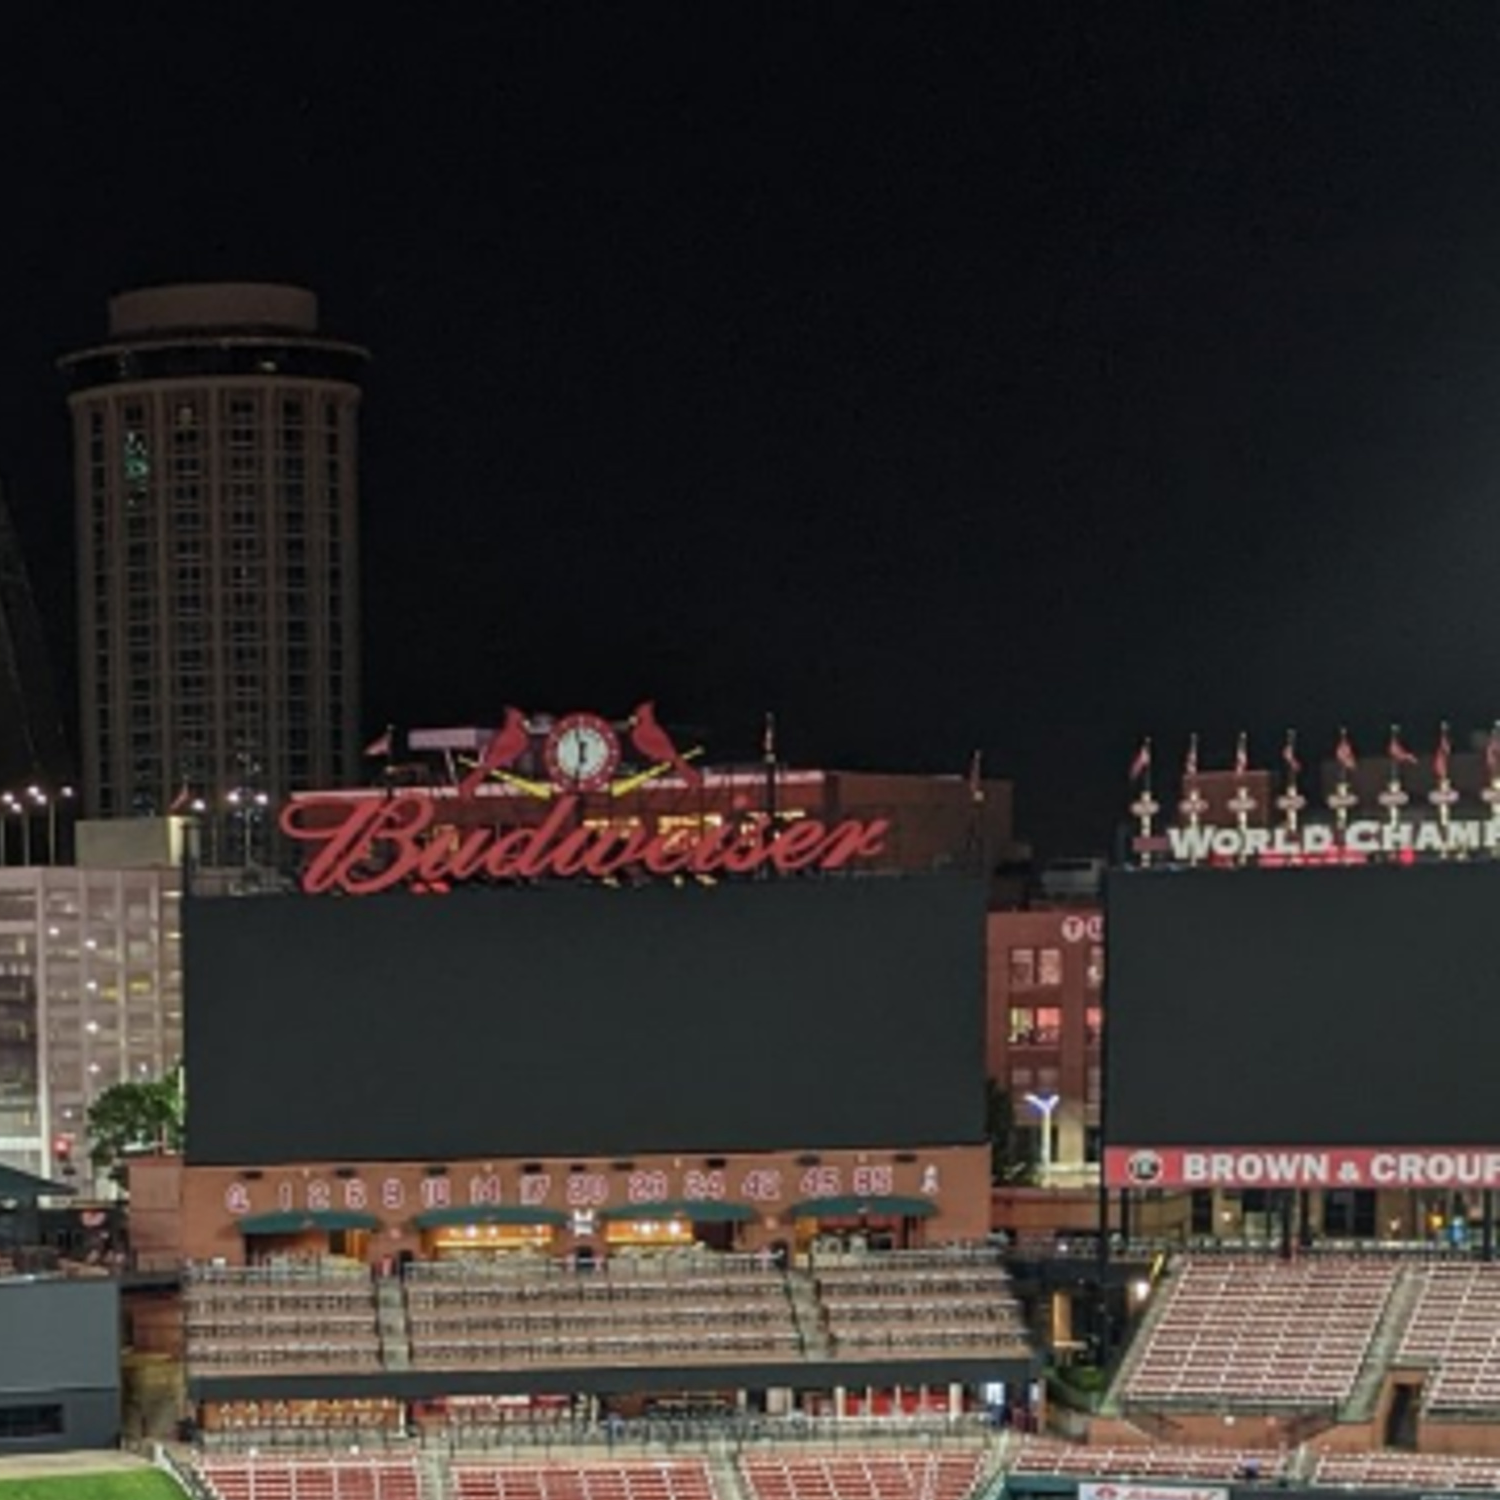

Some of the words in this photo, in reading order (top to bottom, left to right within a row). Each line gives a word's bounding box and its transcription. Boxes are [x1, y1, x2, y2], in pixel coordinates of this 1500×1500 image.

[279, 788, 889, 894] Budweiser
[1167, 824, 1333, 859] WORLD
[1183, 1152, 1328, 1182] BROWN
[1338, 1160, 1360, 1182] &
